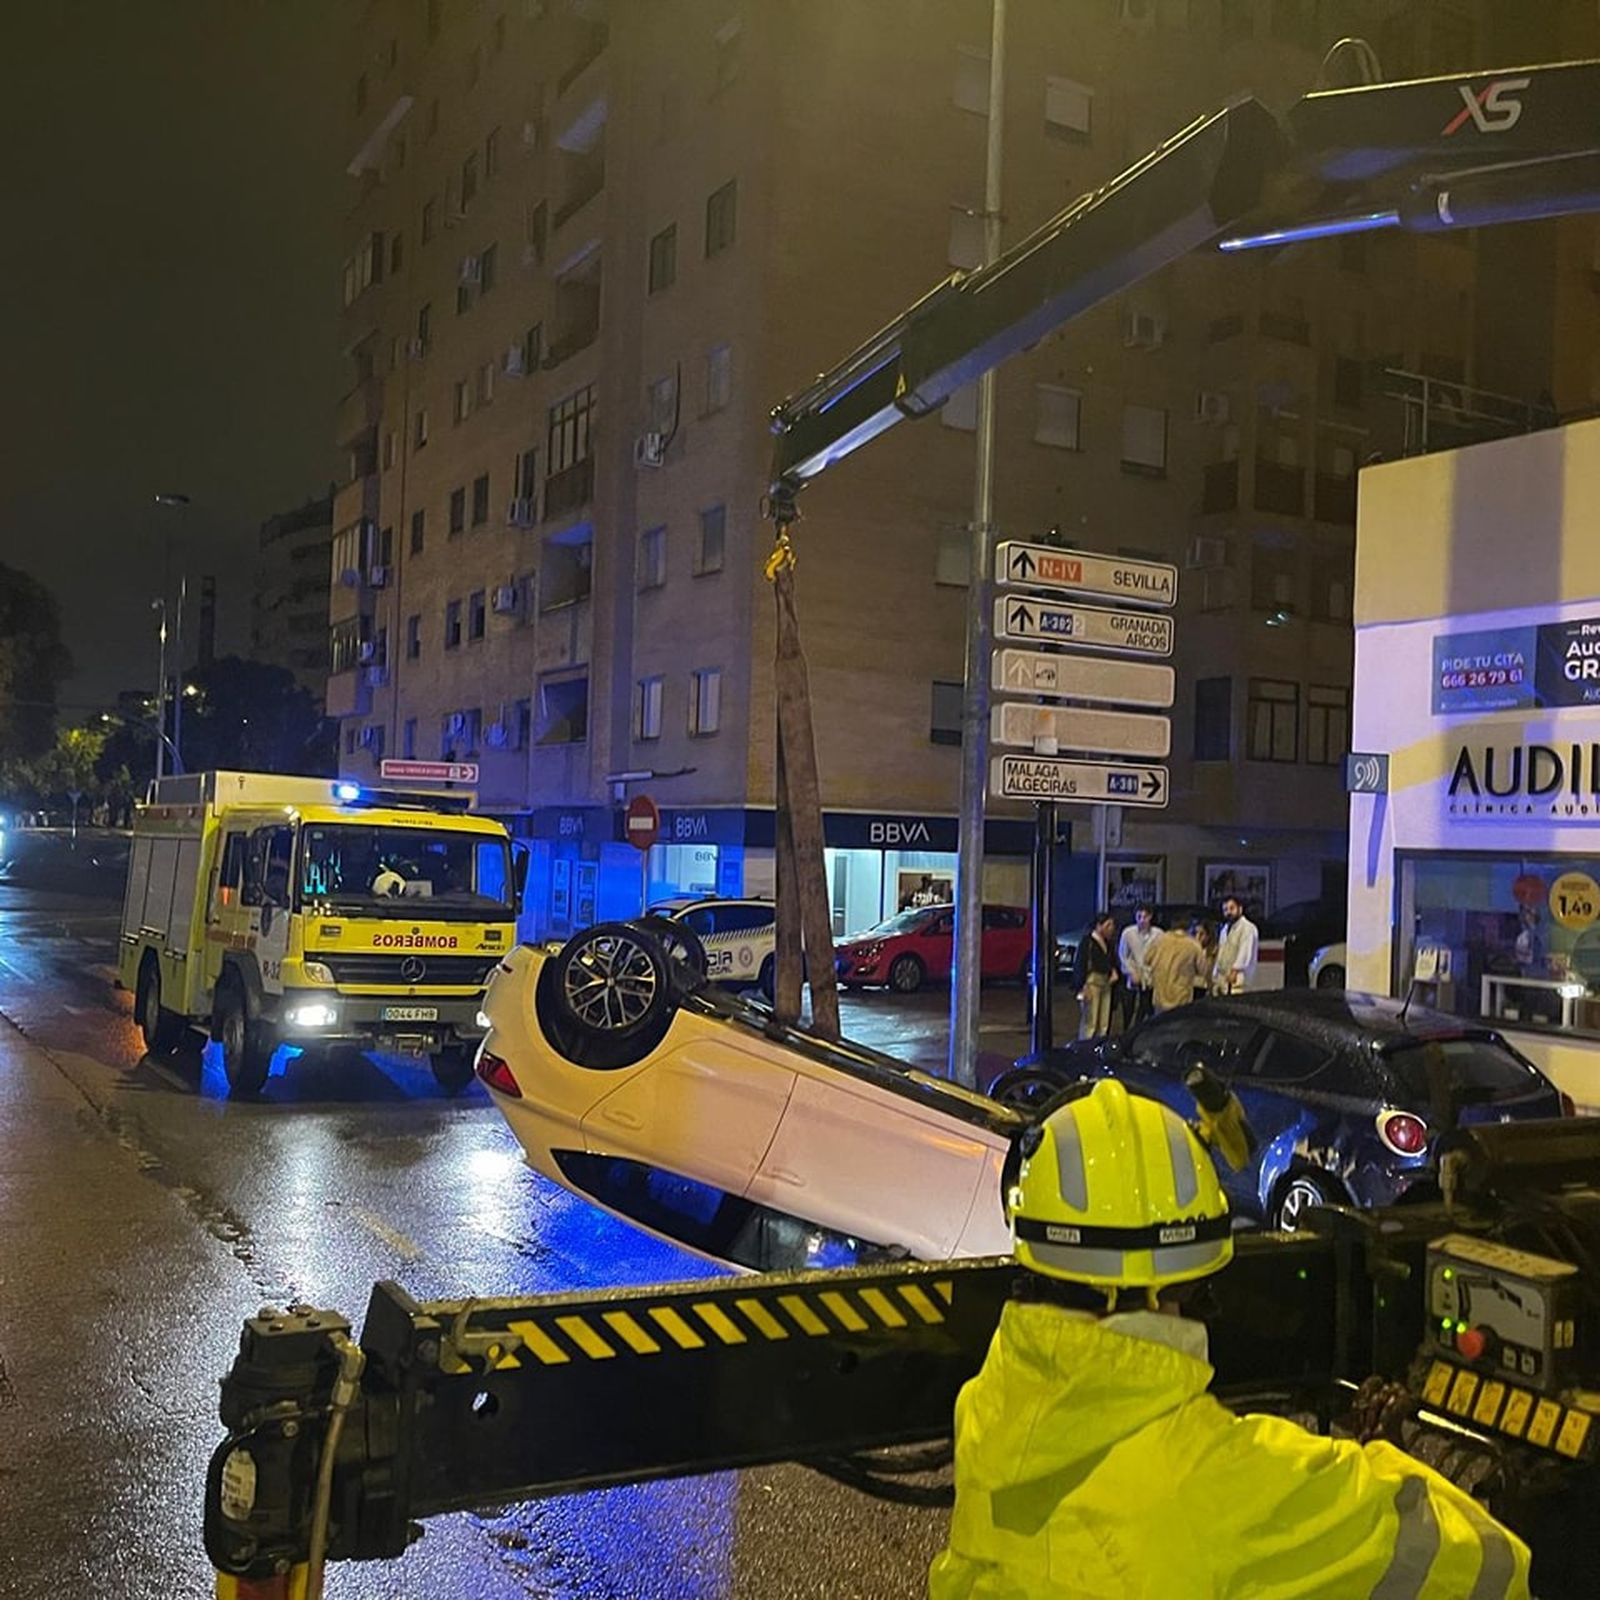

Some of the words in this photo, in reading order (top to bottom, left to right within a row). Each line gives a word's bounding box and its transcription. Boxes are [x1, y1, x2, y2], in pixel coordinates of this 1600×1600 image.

[1441, 78, 1532, 136] XS
[1113, 570, 1170, 593] SEVILLA
[1110, 616, 1167, 634] GRANADA
[1126, 633, 1167, 649] ARCOS
[1474, 655, 1491, 667] TU
[1494, 652, 1524, 667] CITA
[1564, 659, 1600, 681] GR
[1007, 762, 1059, 778] MALAGA
[1007, 777, 1077, 794] ALGECIRAS
[559, 816, 584, 834] BBVA
[676, 816, 708, 837] BBVA
[871, 823, 930, 843] BBVA
